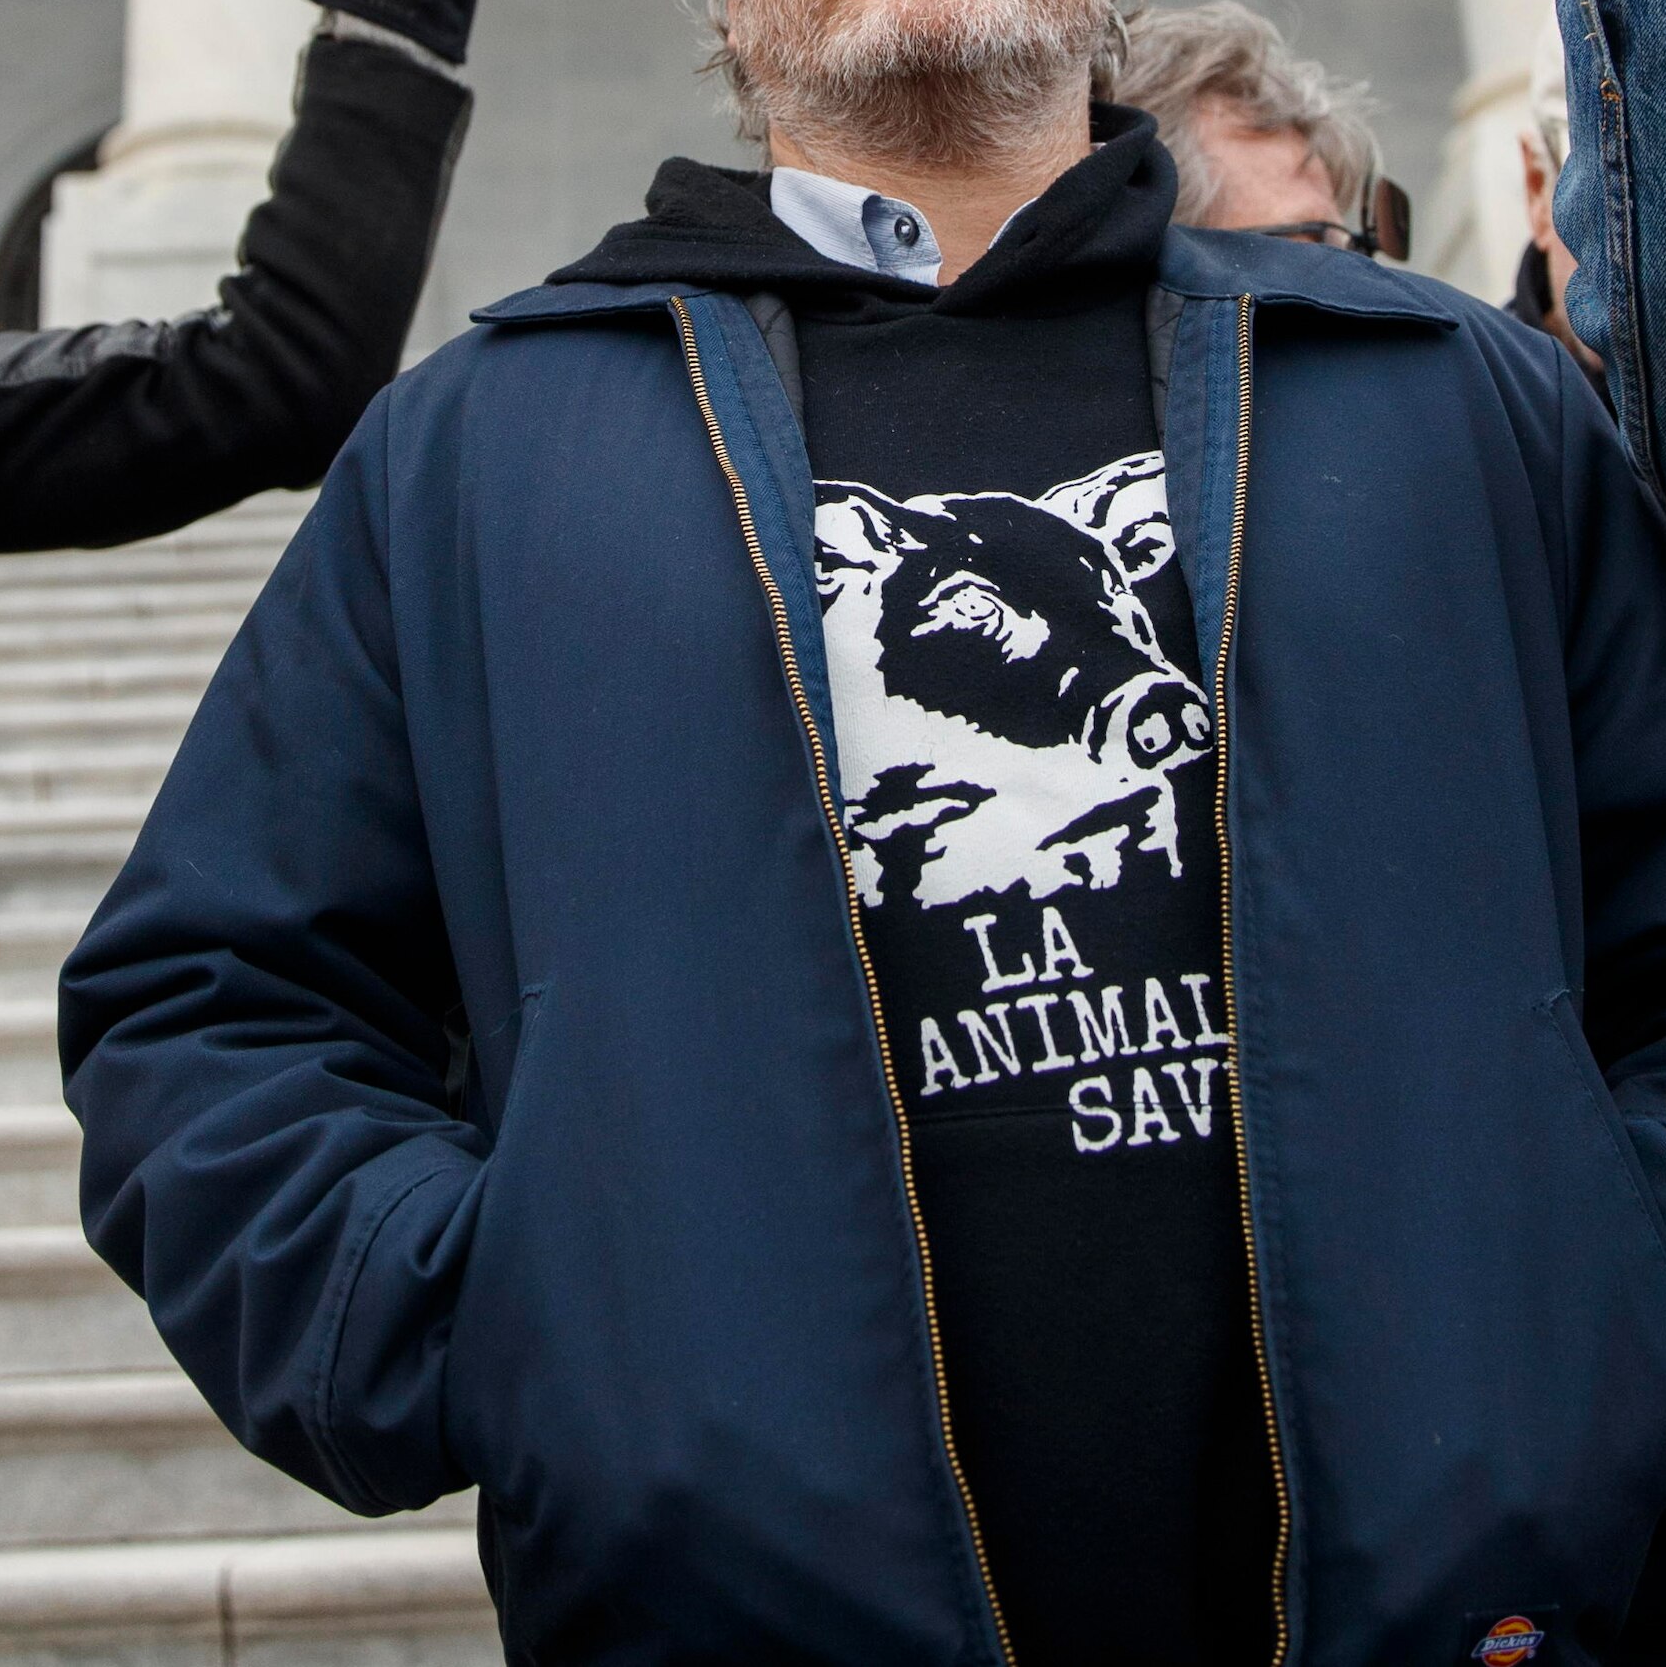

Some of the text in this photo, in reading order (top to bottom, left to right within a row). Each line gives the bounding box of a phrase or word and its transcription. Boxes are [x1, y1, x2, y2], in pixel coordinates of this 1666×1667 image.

[963, 906, 1094, 993] LA
[920, 973, 1232, 1097] ANIMAL
[1068, 1058, 1233, 1154] SAV
[1480, 1636, 1536, 1652] Dickies
